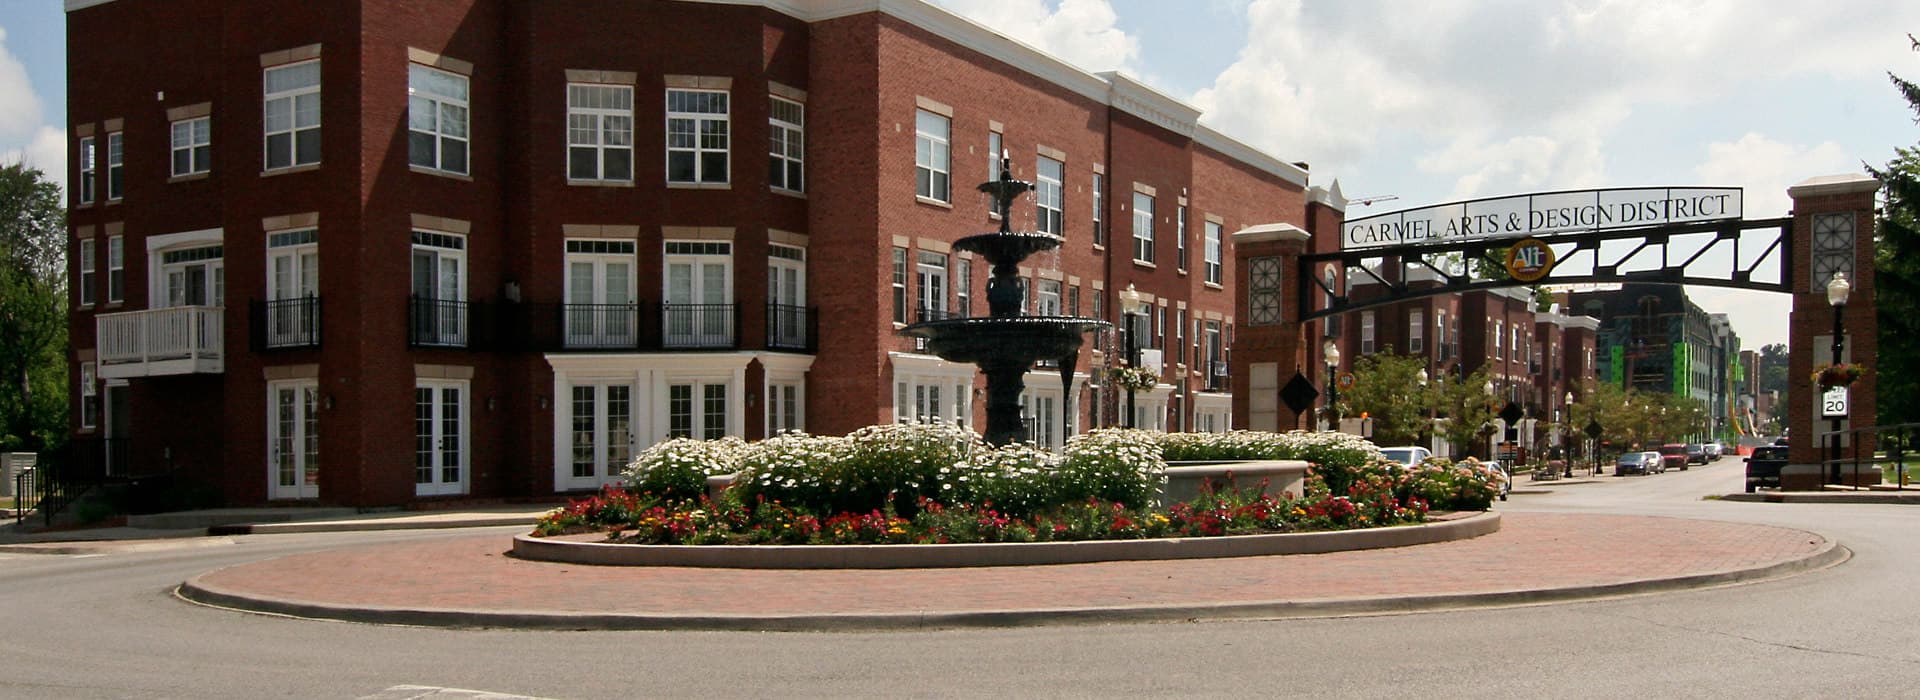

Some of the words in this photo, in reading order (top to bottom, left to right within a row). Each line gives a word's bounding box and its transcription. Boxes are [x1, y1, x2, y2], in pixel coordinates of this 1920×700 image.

[1350, 219, 1437, 244] CARMEL
[1445, 214, 1499, 237] ARTS
[1505, 212, 1521, 232] &
[1531, 204, 1613, 230] DESIGN
[1621, 194, 1730, 223] DISTRICT
[1826, 400, 1844, 412] 20
